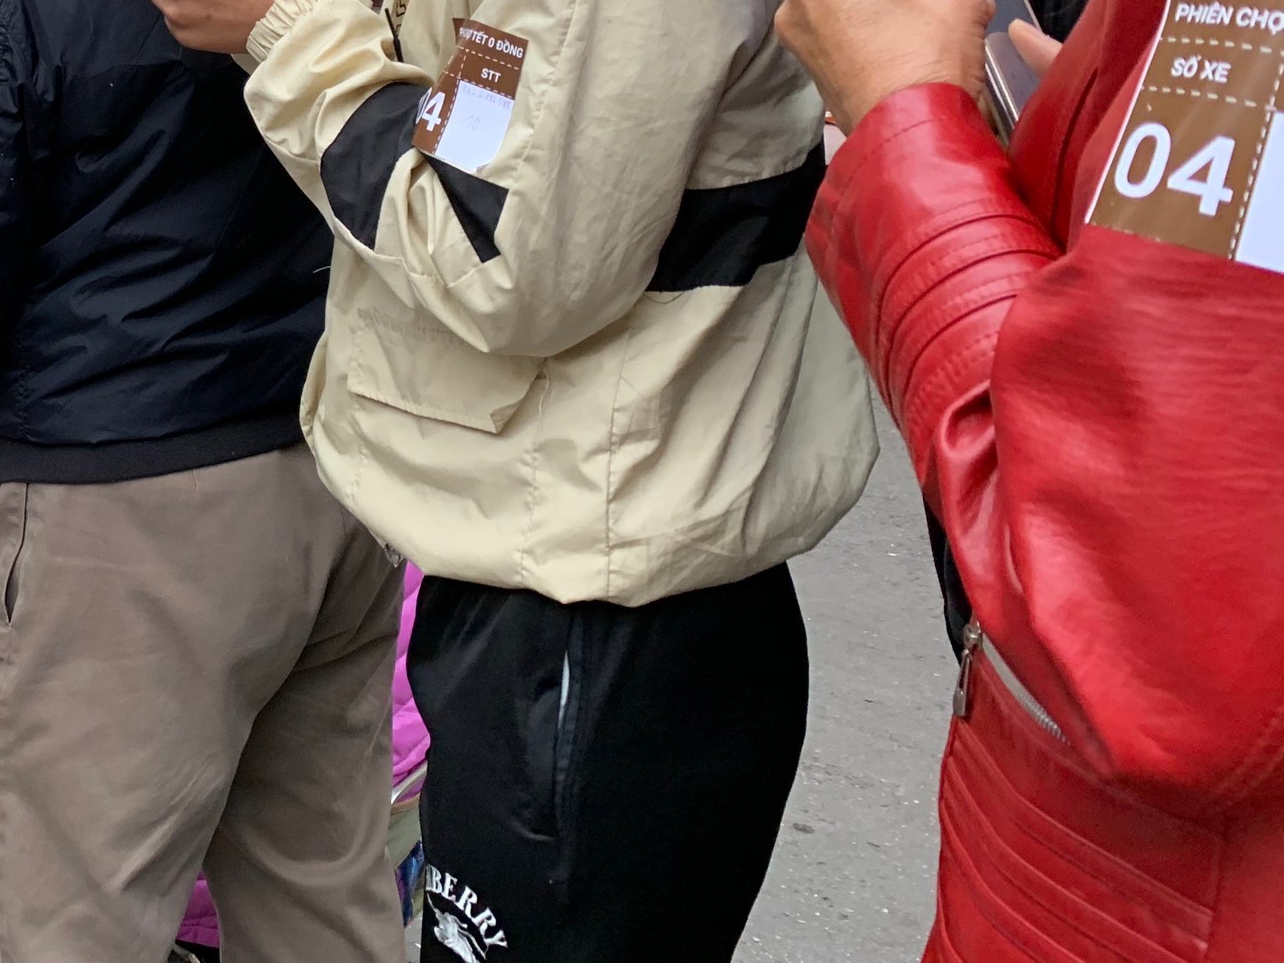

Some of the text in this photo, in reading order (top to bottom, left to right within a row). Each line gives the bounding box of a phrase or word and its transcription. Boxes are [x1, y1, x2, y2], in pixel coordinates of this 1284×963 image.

[1175, 1, 1233, 25] PHIÊN
[481, 67, 501, 83] STT
[1170, 53, 1232, 84] SỐ XE
[1114, 121, 1236, 217] 04
